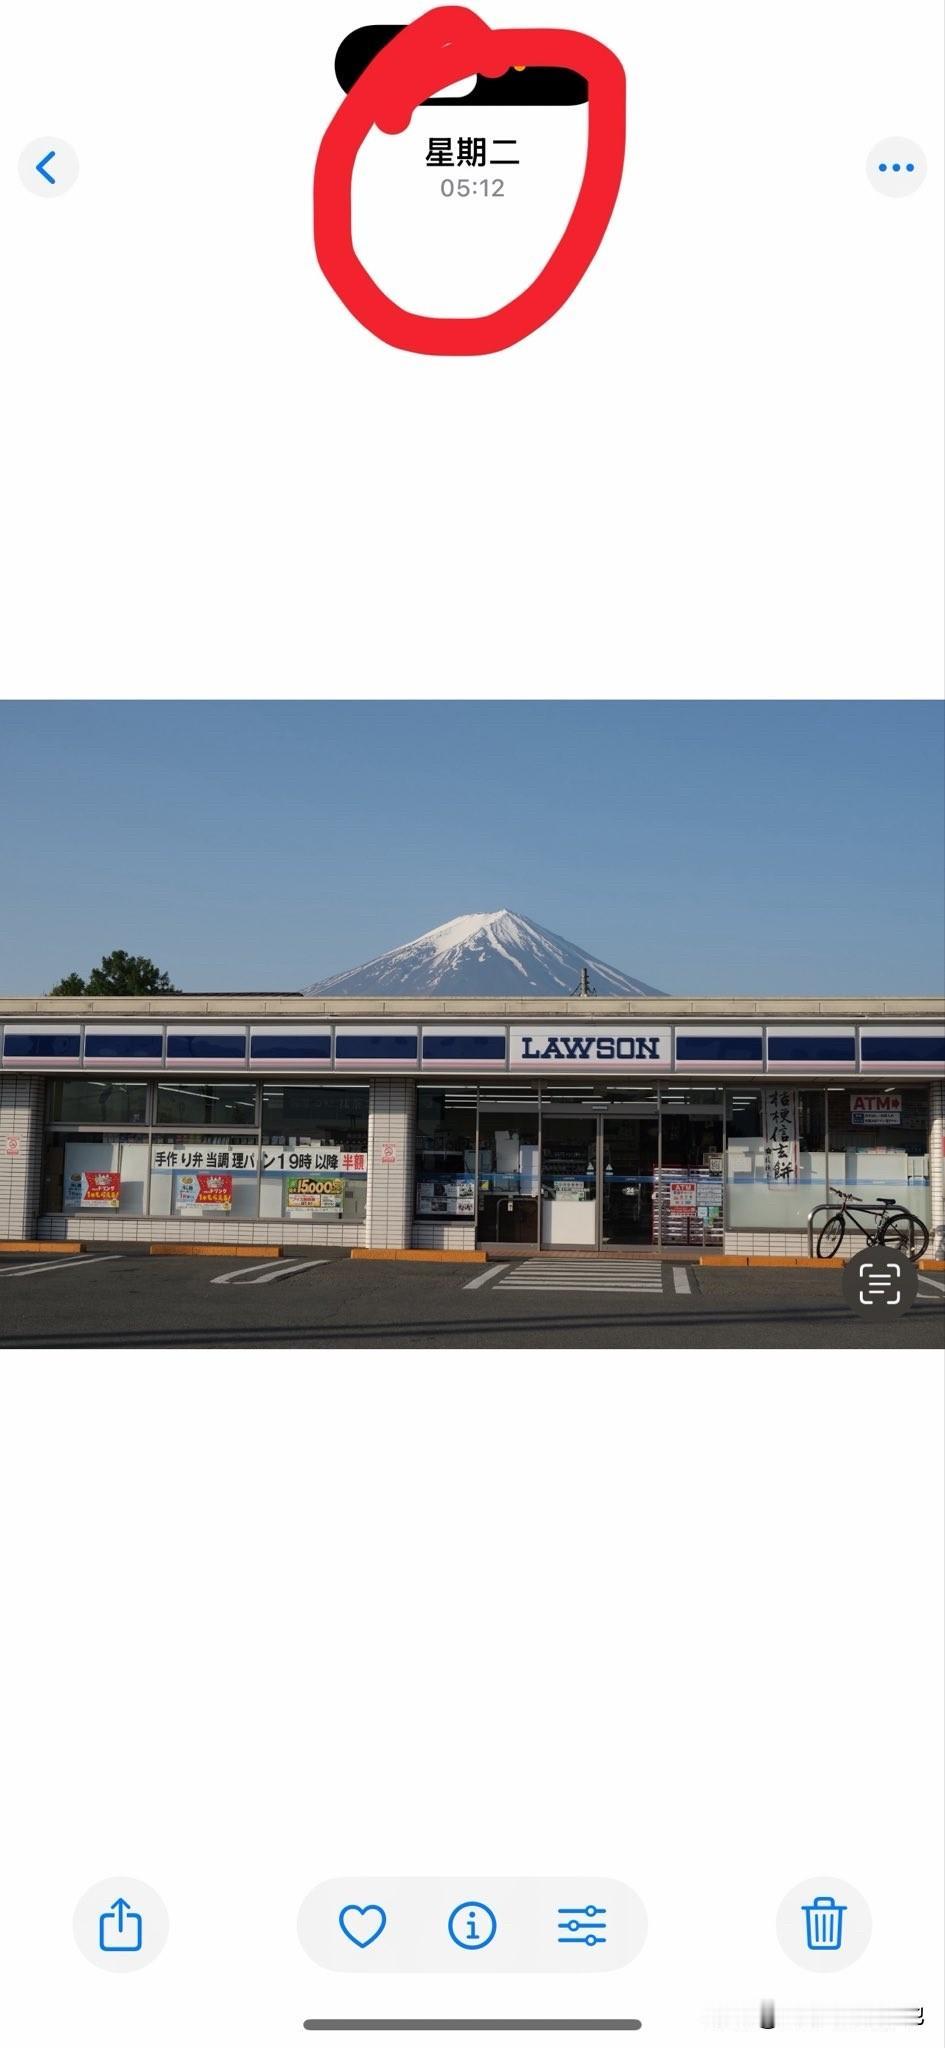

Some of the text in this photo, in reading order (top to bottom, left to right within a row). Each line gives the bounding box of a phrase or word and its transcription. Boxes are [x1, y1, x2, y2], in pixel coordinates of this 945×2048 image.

[425, 137, 520, 167] 星期二
[440, 178, 505, 197] 05:12
[521, 1037, 660, 1059] LAWSON
[853, 1096, 890, 1110] ATM
[769, 1091, 793, 1185] 桔梗信玄餅
